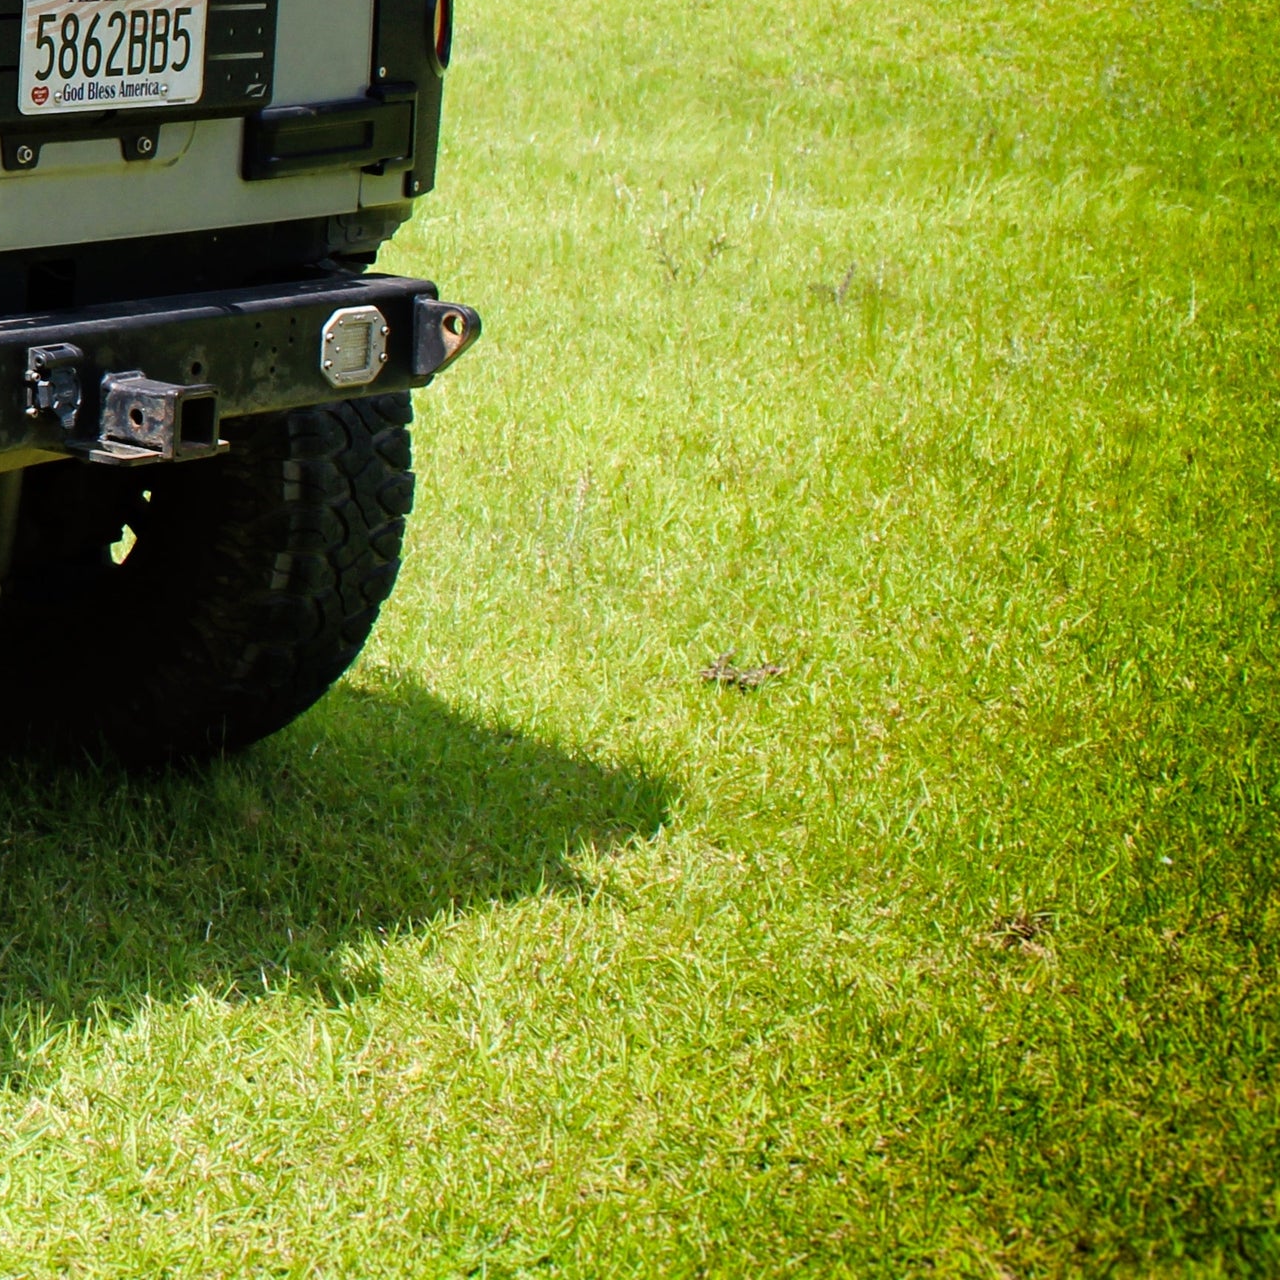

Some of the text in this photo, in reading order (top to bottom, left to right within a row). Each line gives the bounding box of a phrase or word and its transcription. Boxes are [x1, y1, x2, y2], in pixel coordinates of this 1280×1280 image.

[35, 7, 192, 81] 5862BB5
[63, 83, 85, 102] God
[87, 81, 116, 100] Bless
[119, 77, 160, 98] America
